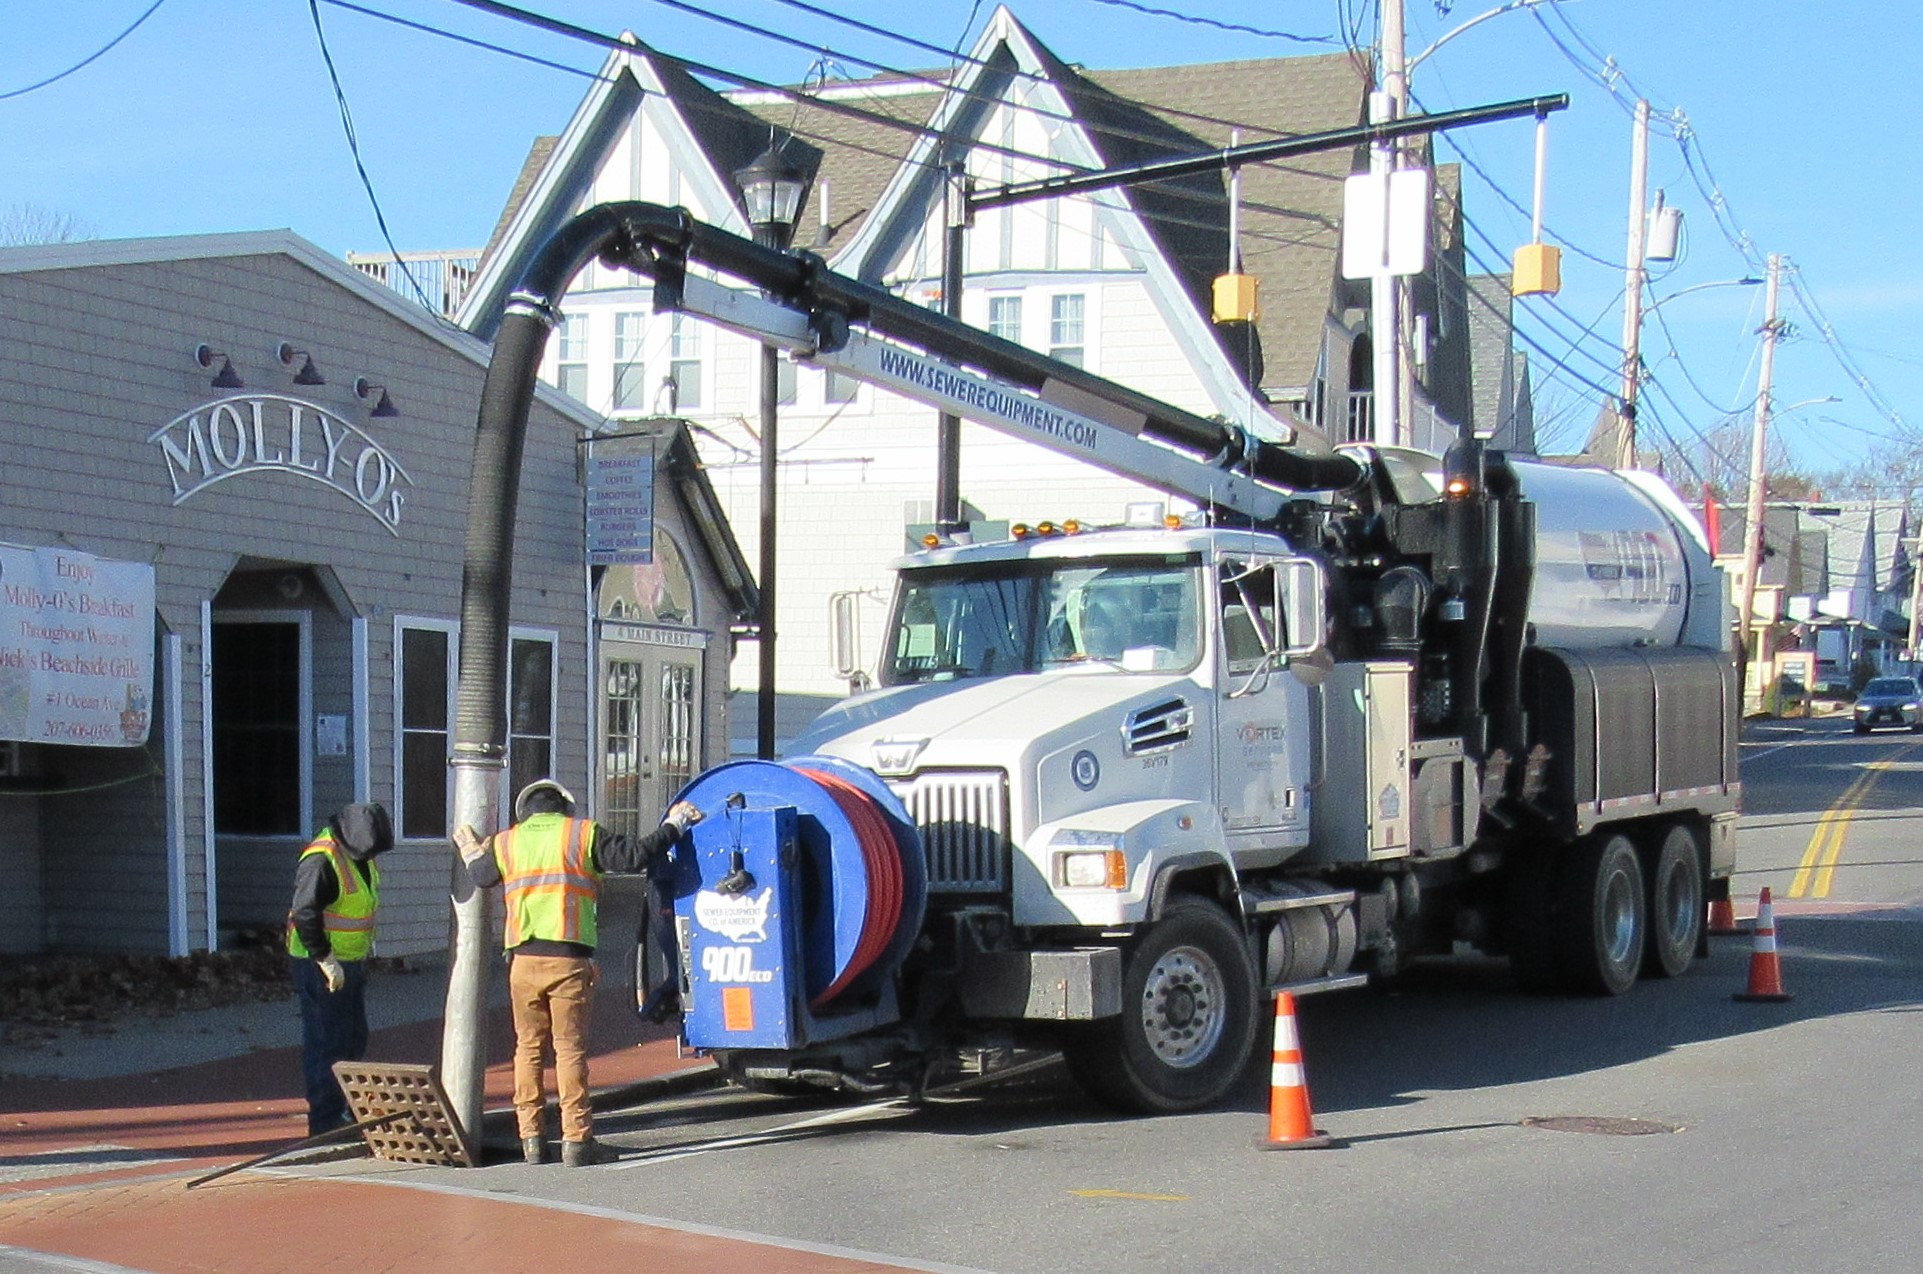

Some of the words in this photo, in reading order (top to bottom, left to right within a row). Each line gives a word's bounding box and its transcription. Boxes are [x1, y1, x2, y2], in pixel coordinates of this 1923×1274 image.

[880, 348, 1097, 449] WWW.SEWEREQUIPMENT.COM
[56, 556, 93, 585] Enjoy
[627, 627, 652, 641] MAIN
[654, 631, 692, 645] STREET
[41, 651, 106, 676] Beachside
[1236, 723, 1285, 742] VORTEX
[703, 907, 724, 917] SEWER
[725, 907, 761, 918] EQUIPMENT
[728, 917, 757, 926] AMERICA
[702, 946, 753, 982] 900
